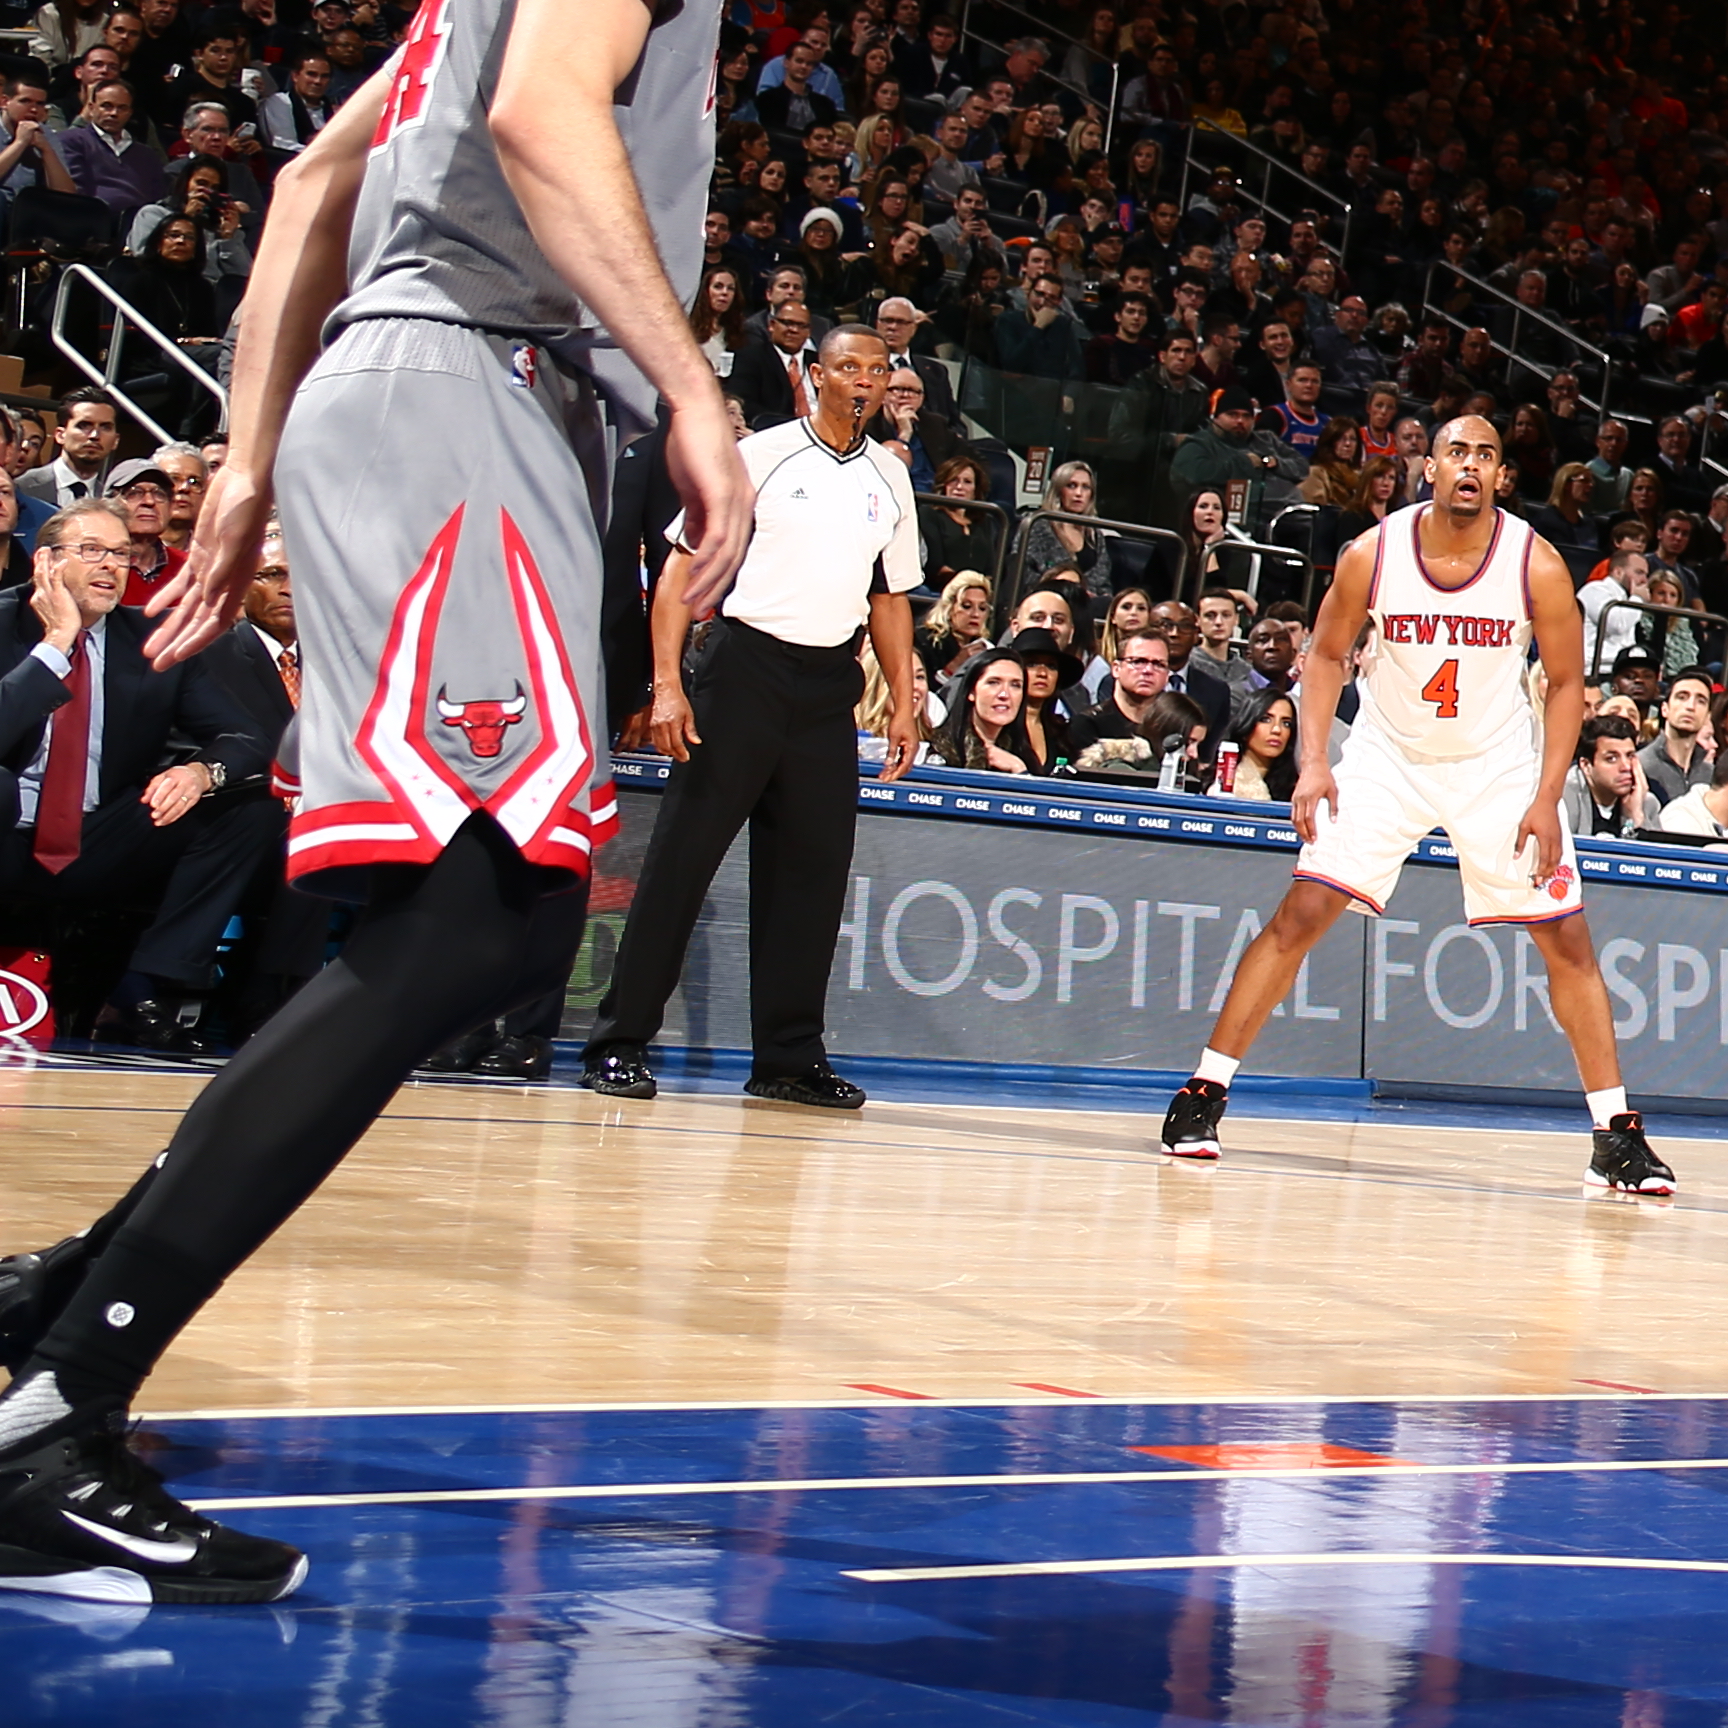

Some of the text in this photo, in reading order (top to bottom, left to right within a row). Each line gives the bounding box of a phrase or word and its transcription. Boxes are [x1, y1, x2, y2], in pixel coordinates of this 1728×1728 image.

[1382, 613, 1516, 648] NEW YORK
[1421, 658, 1459, 719] 4
[860, 787, 895, 802] CHASE
[908, 792, 943, 807] CHASE
[955, 797, 990, 812] CHASE
[1002, 802, 1036, 817] CHASE
[1048, 807, 1081, 821] CHASE
[1093, 812, 1126, 826] CHASE
[1137, 816, 1170, 830] CHASE
[1181, 820, 1213, 834] CHASE
[1224, 824, 1256, 838] CHASE
[1267, 829, 1298, 842] CHASE
[1374, 918, 1562, 1032] FOR
